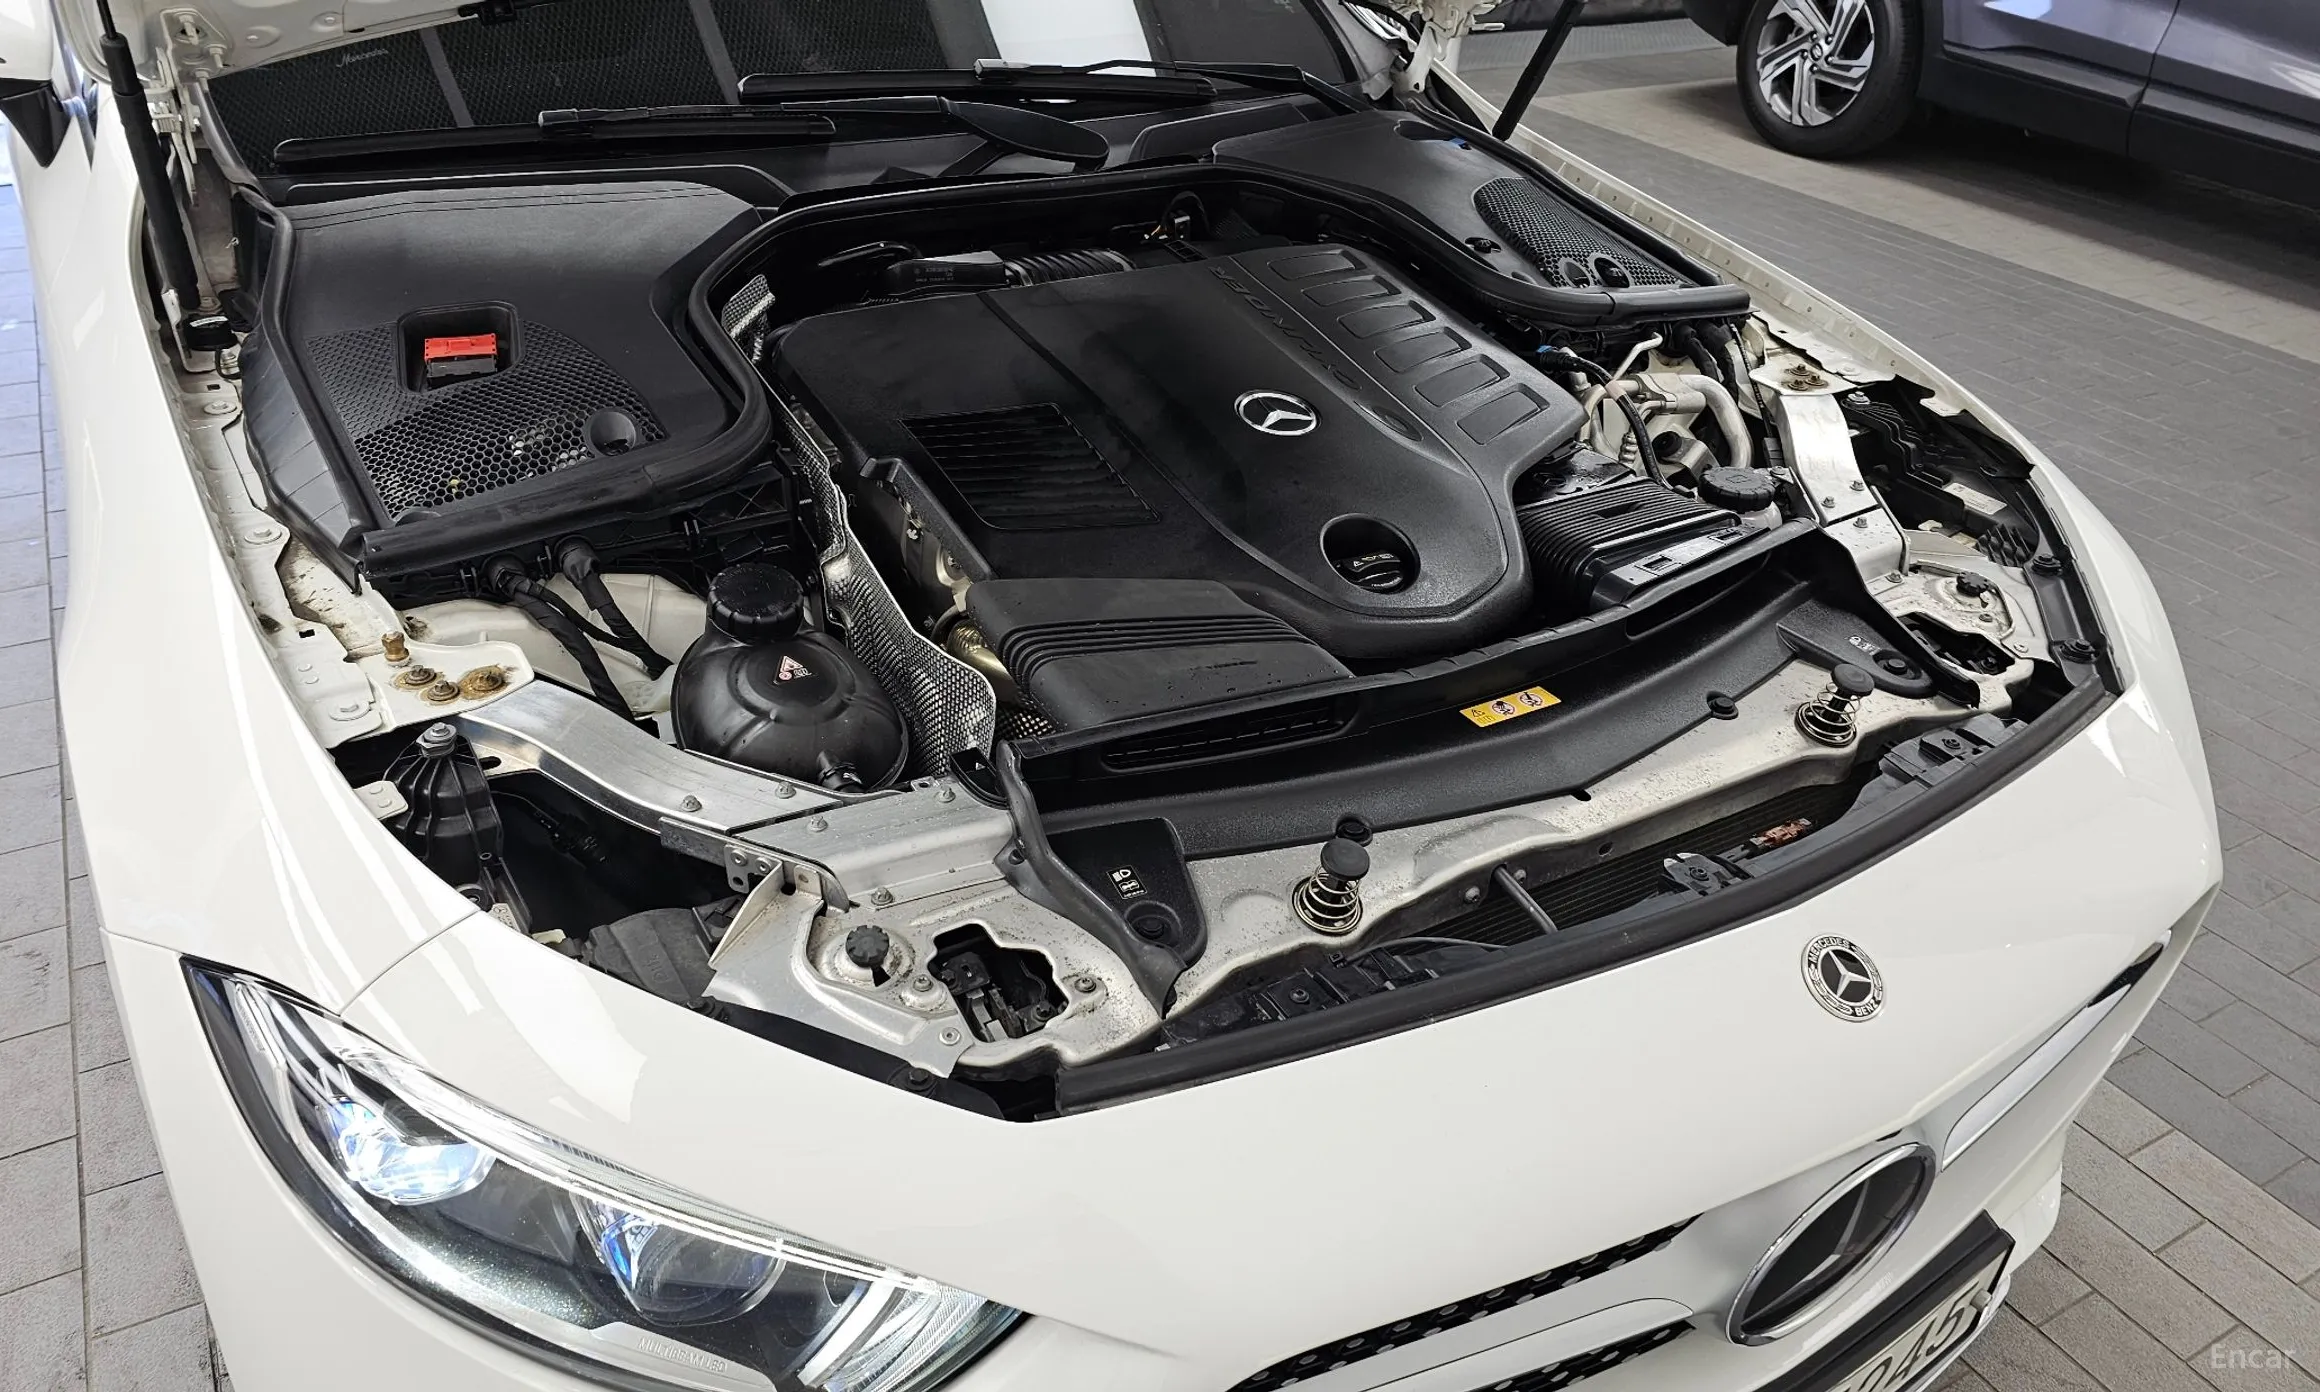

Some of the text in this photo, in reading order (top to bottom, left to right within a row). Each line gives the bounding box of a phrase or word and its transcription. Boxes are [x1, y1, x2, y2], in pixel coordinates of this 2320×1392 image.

[1808, 936, 1851, 963] MERCEDES
[1854, 998, 1879, 1017] BENZ
[638, 1337, 729, 1373] MULTIBEAM LED
